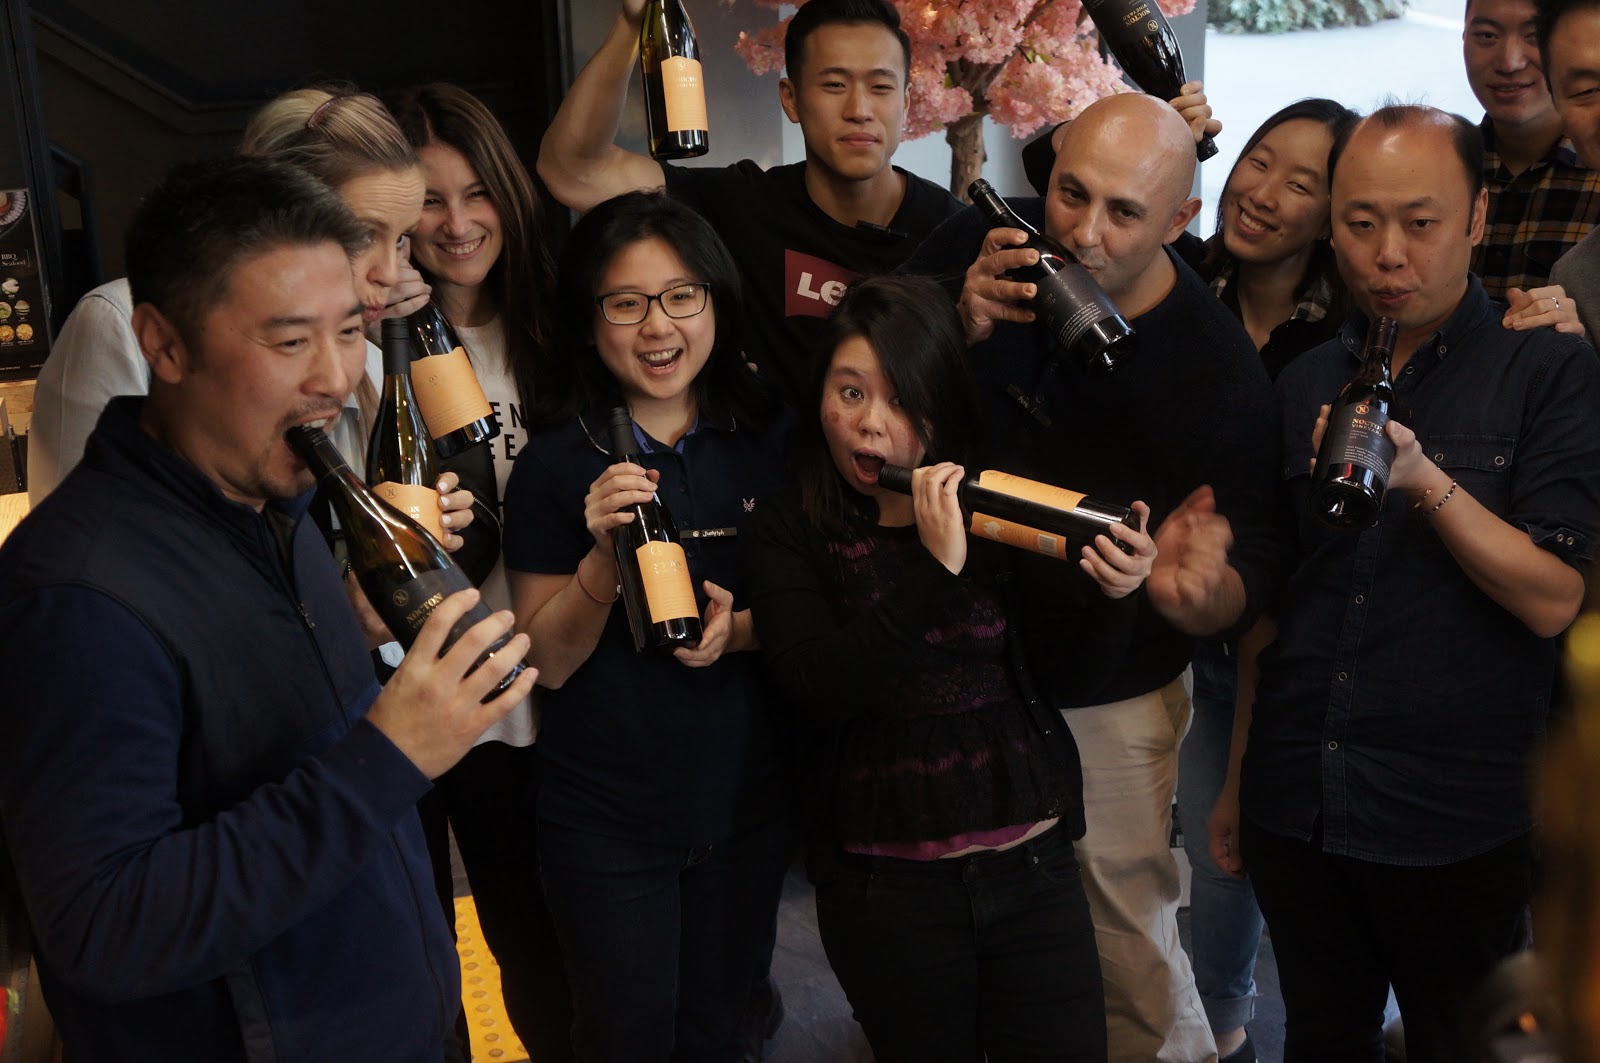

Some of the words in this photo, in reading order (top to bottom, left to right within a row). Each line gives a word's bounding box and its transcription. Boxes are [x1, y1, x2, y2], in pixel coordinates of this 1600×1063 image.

[1125, 8, 1151, 26] NOCTON
[797, 271, 848, 306] Le
[406, 592, 443, 624] NOCTON
